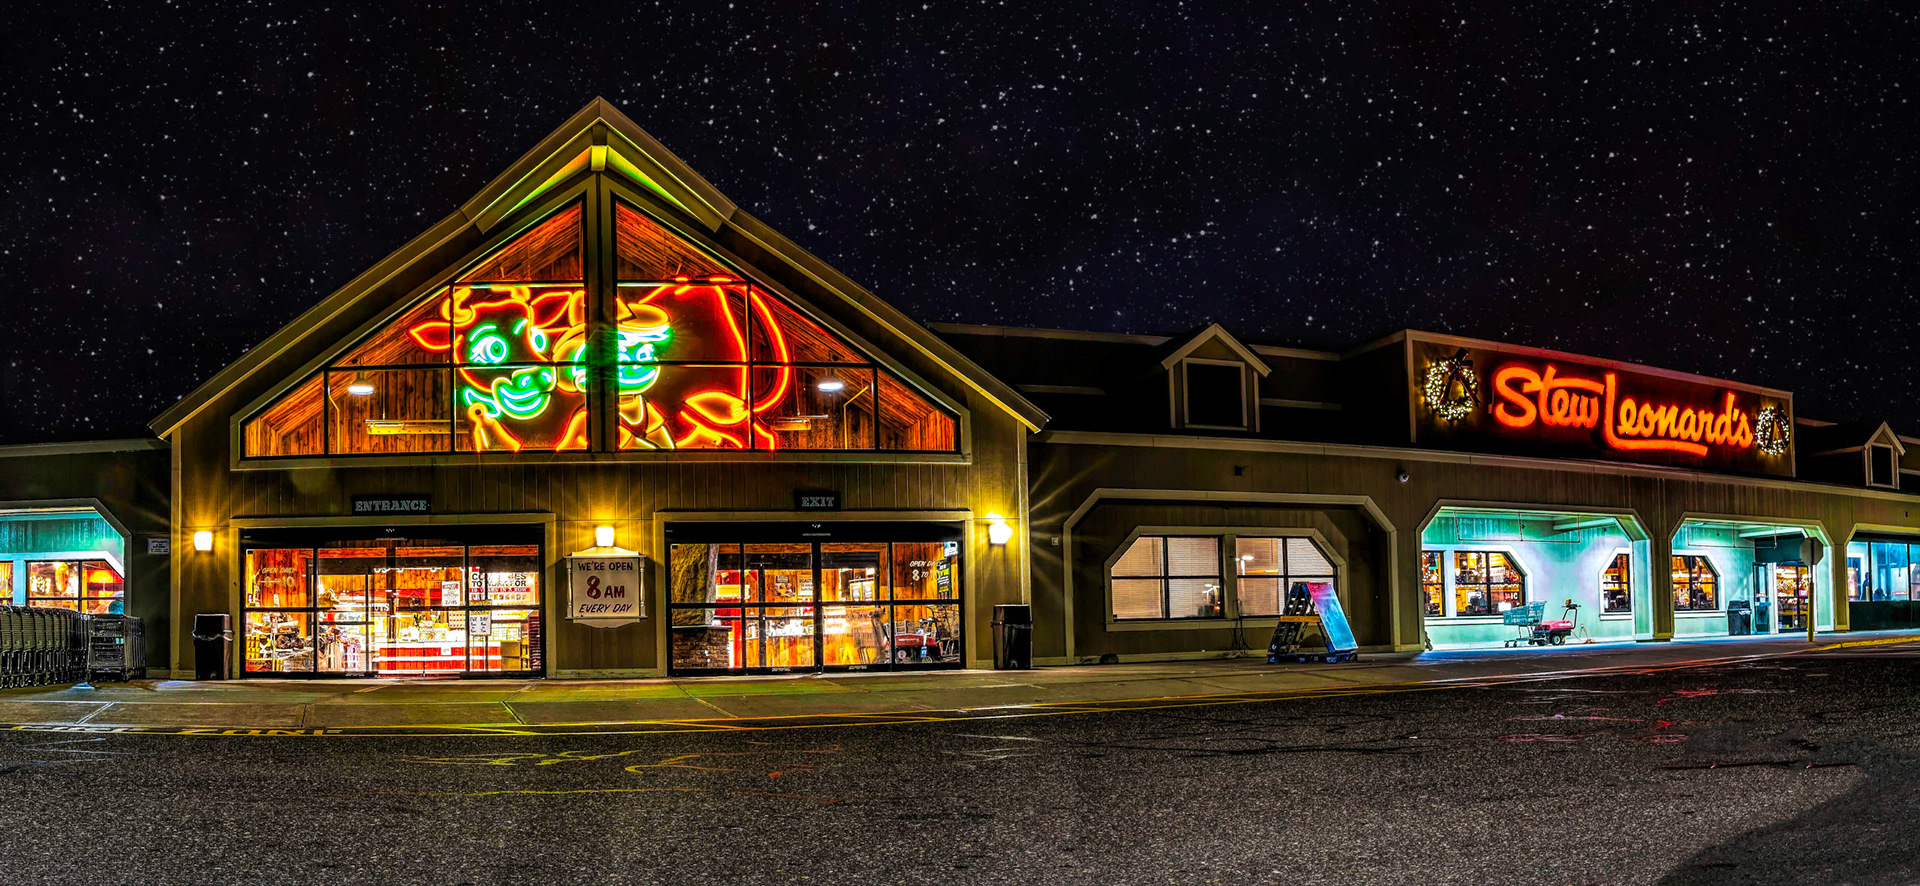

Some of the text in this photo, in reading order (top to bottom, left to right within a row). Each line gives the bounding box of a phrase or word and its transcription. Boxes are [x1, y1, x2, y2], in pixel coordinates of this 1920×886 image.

[1494, 364, 1754, 456] Stew Leonard's
[355, 500, 427, 512] ENTRANCE
[801, 496, 835, 507] EXIT
[577, 560, 634, 571] WE'RE OPEN
[912, 568, 920, 582] 8
[586, 575, 625, 600] 8 AM
[579, 603, 633, 613] EVERY DAY
